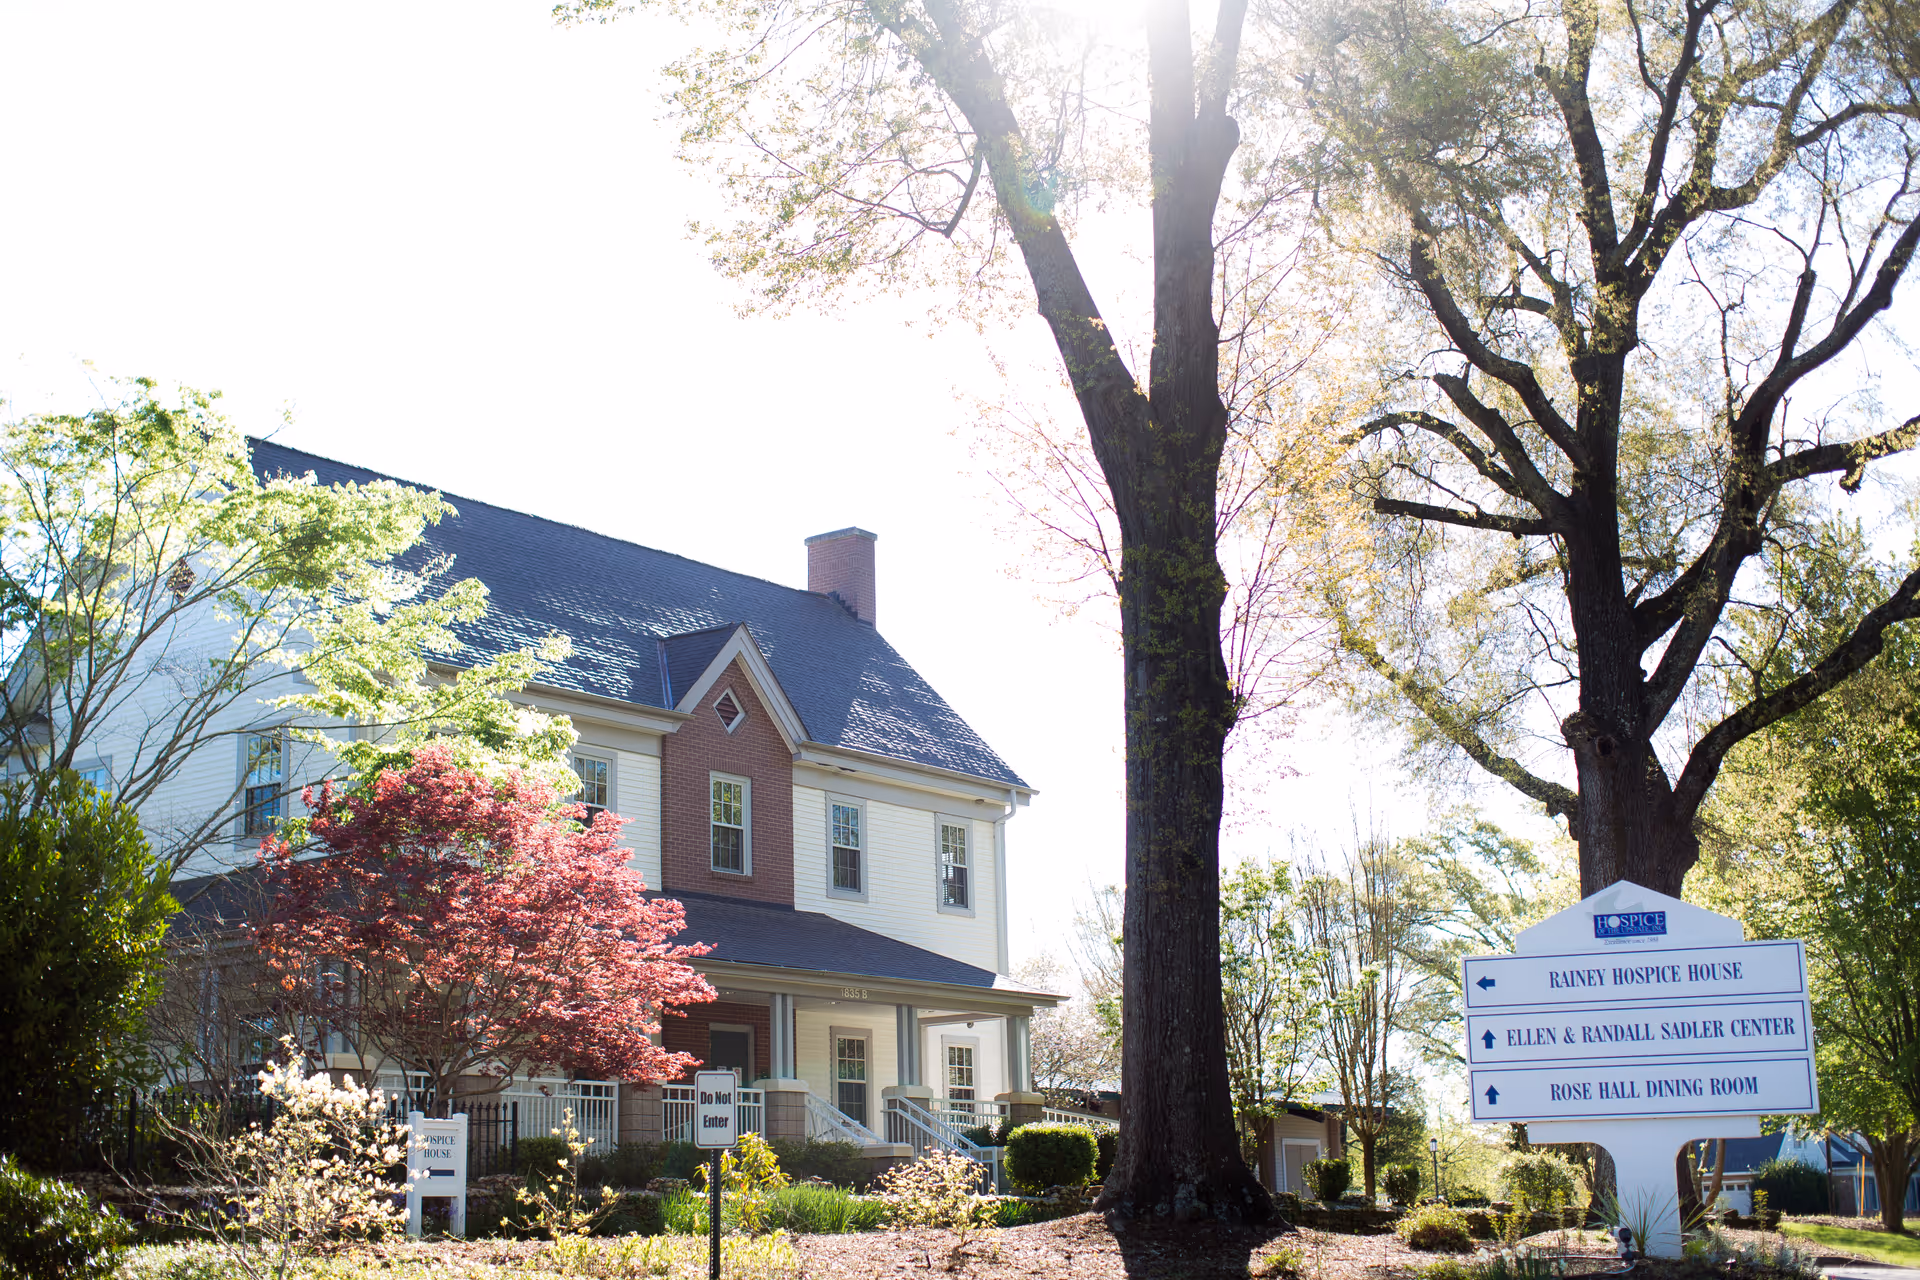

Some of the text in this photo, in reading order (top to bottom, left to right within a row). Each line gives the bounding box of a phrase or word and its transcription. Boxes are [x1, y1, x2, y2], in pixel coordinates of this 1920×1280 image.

[1597, 913, 1664, 928] HOSPICE
[1549, 961, 1743, 989] RAINEY HOSPICE HOUSE
[841, 987, 868, 999] 1835 B
[1507, 1017, 1796, 1047] ELLEN & RANDALL SADLER CENTER
[1550, 1076, 1759, 1101] ROSE HALL DINING ROOM
[700, 1091, 732, 1105] Do Not
[703, 1114, 729, 1128] Enter
[424, 1149, 452, 1158] HOUSE
